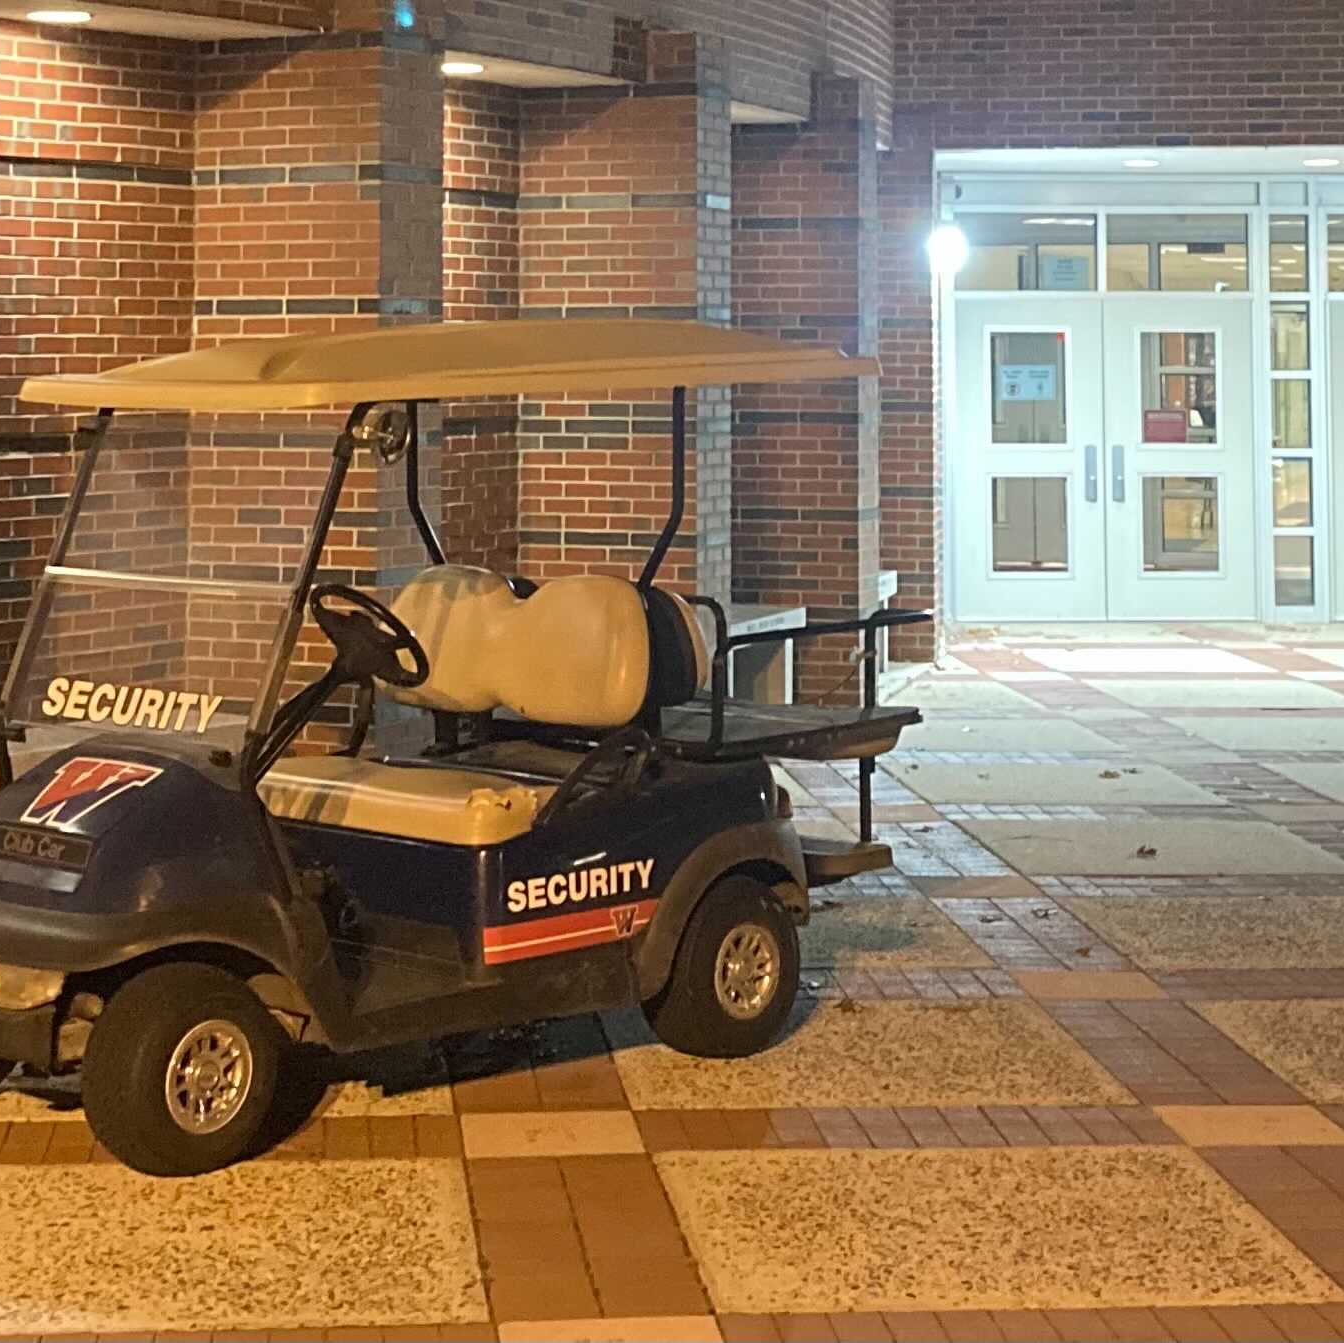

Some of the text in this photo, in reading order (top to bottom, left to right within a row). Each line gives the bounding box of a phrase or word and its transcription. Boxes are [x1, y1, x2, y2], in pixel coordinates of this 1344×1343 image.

[41, 677, 224, 734] SECURITY
[20, 756, 164, 830] W
[3, 830, 66, 859] Club Car
[507, 858, 655, 913] SECURITY
[610, 905, 639, 937] W
